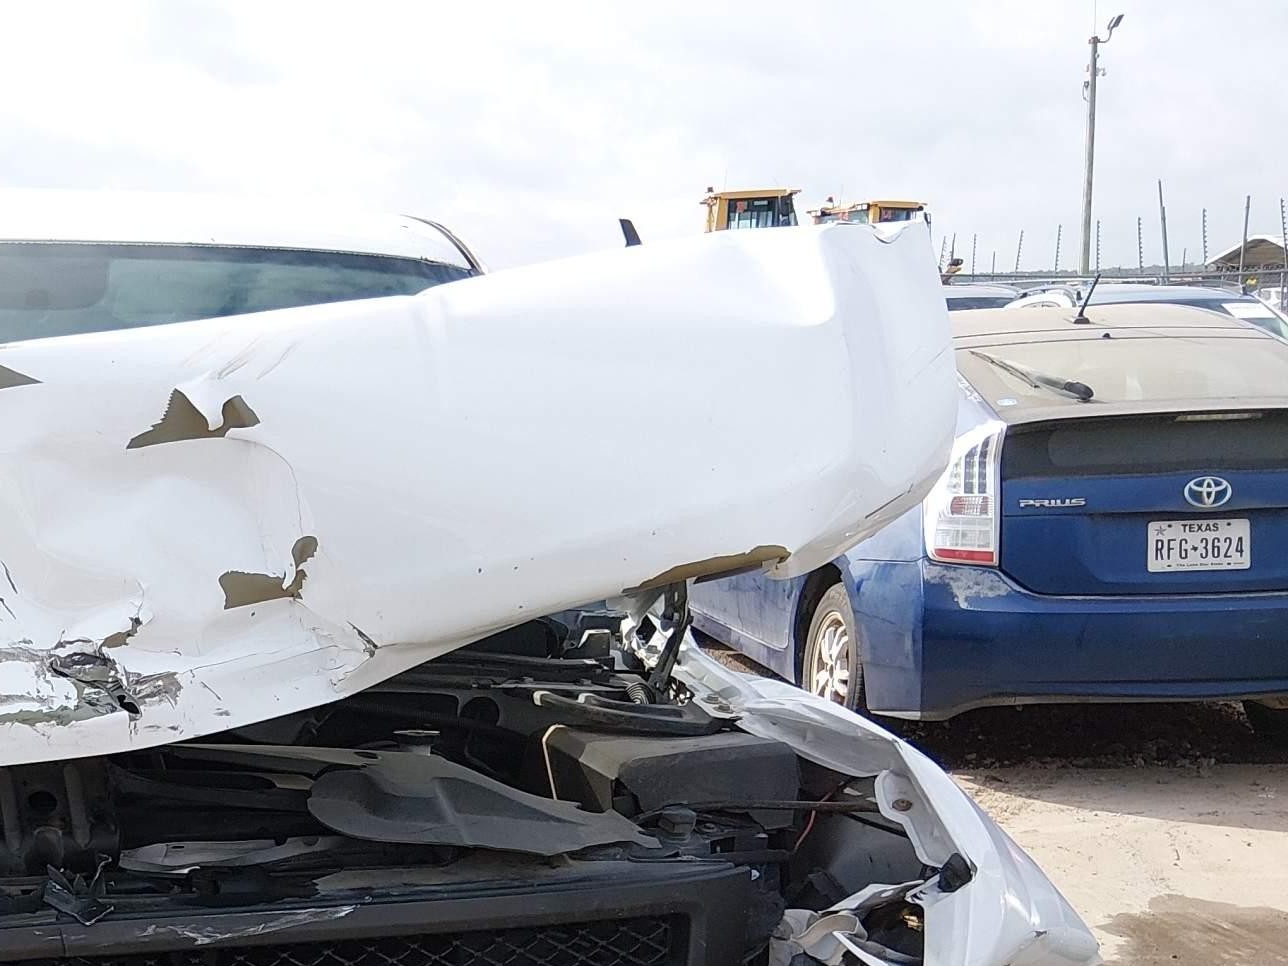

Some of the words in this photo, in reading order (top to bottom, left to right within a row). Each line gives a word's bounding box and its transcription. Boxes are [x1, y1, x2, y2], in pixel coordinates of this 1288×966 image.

[1018, 497, 1087, 508] PRIUS
[1180, 522, 1220, 534] TEXAS
[1154, 538, 1189, 561] RFG
[1199, 536, 1245, 560] 3624
